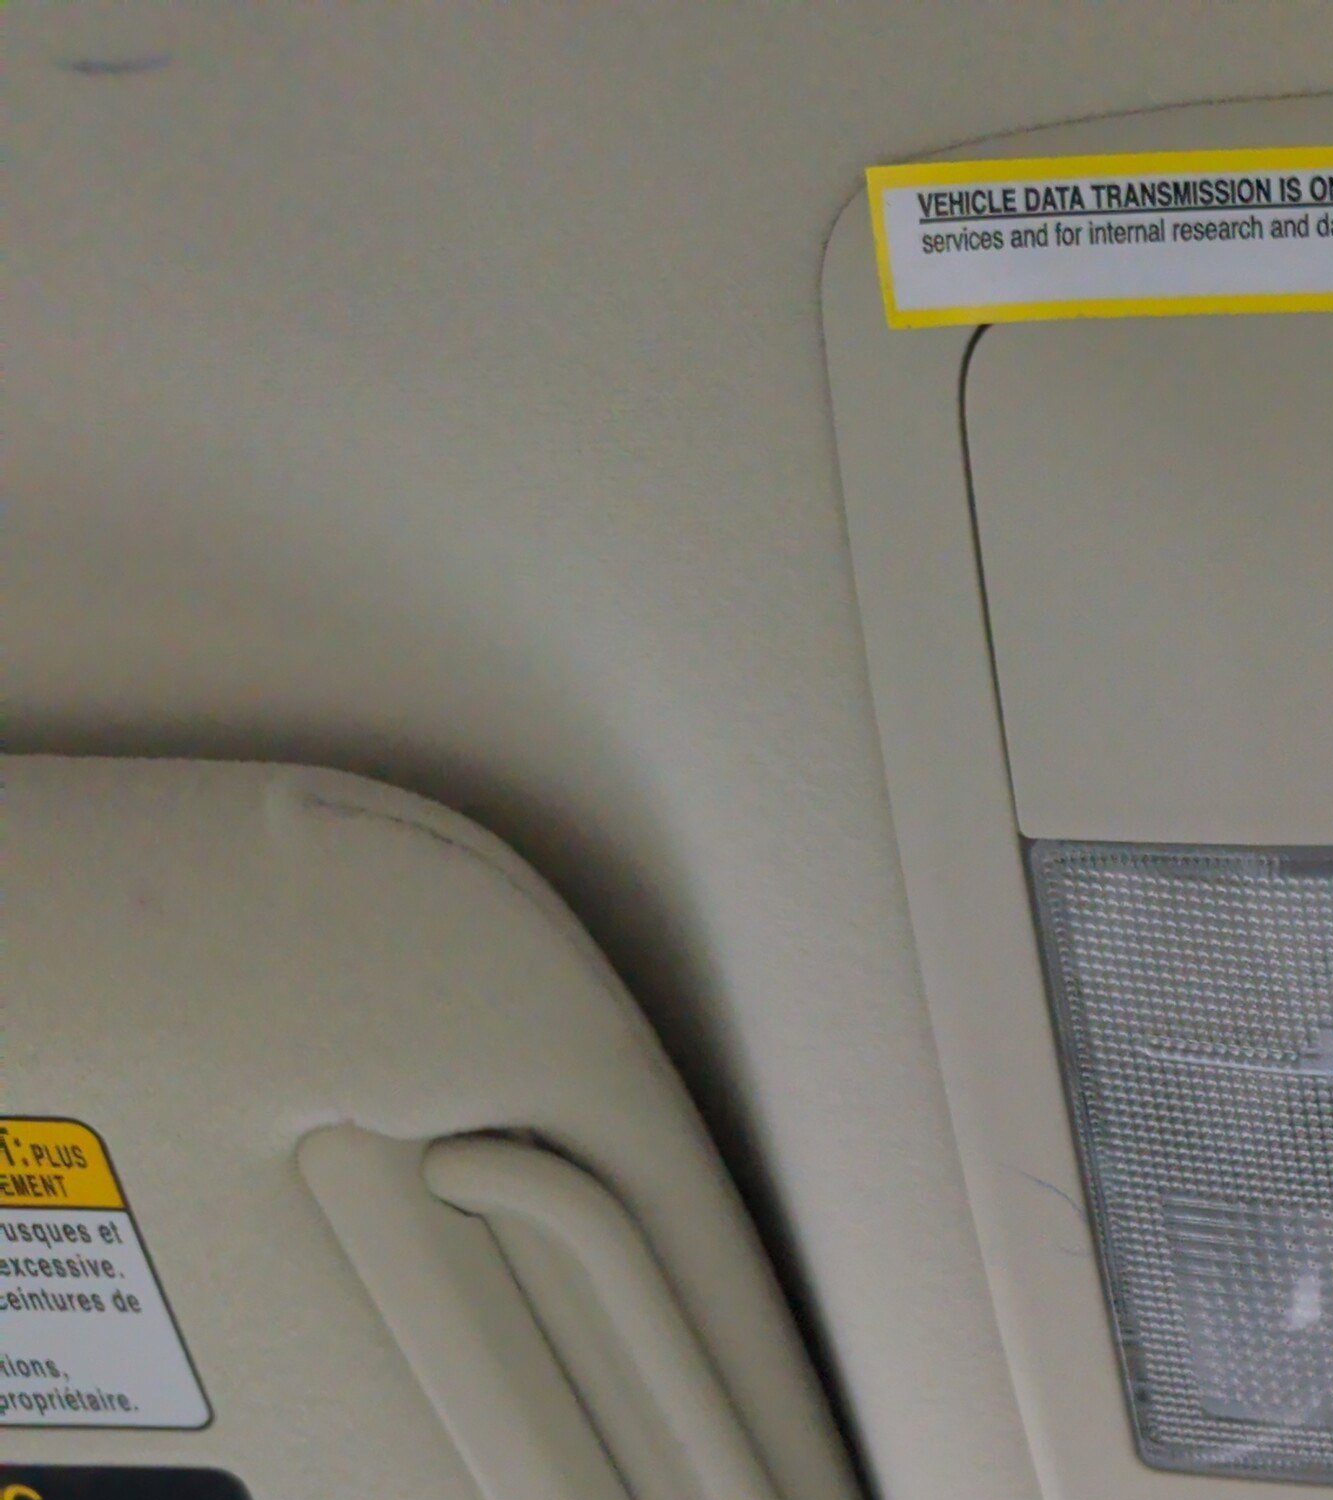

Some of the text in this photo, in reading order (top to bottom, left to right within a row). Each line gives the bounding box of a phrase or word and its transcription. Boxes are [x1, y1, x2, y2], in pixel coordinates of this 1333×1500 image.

[918, 188, 1017, 218] VEHICLE
[1024, 184, 1086, 212] DATA
[1091, 178, 1271, 210] TRANSMISSION
[1279, 176, 1303, 203] IS
[922, 229, 1004, 255] services
[1011, 222, 1048, 249] and
[1055, 221, 1082, 247] for
[1089, 218, 1165, 246] internal
[1172, 214, 1262, 242] research
[1270, 213, 1309, 240] and
[30, 1143, 88, 1169] PLUS
[98, 1220, 123, 1244] et
[112, 1289, 142, 1314] de
